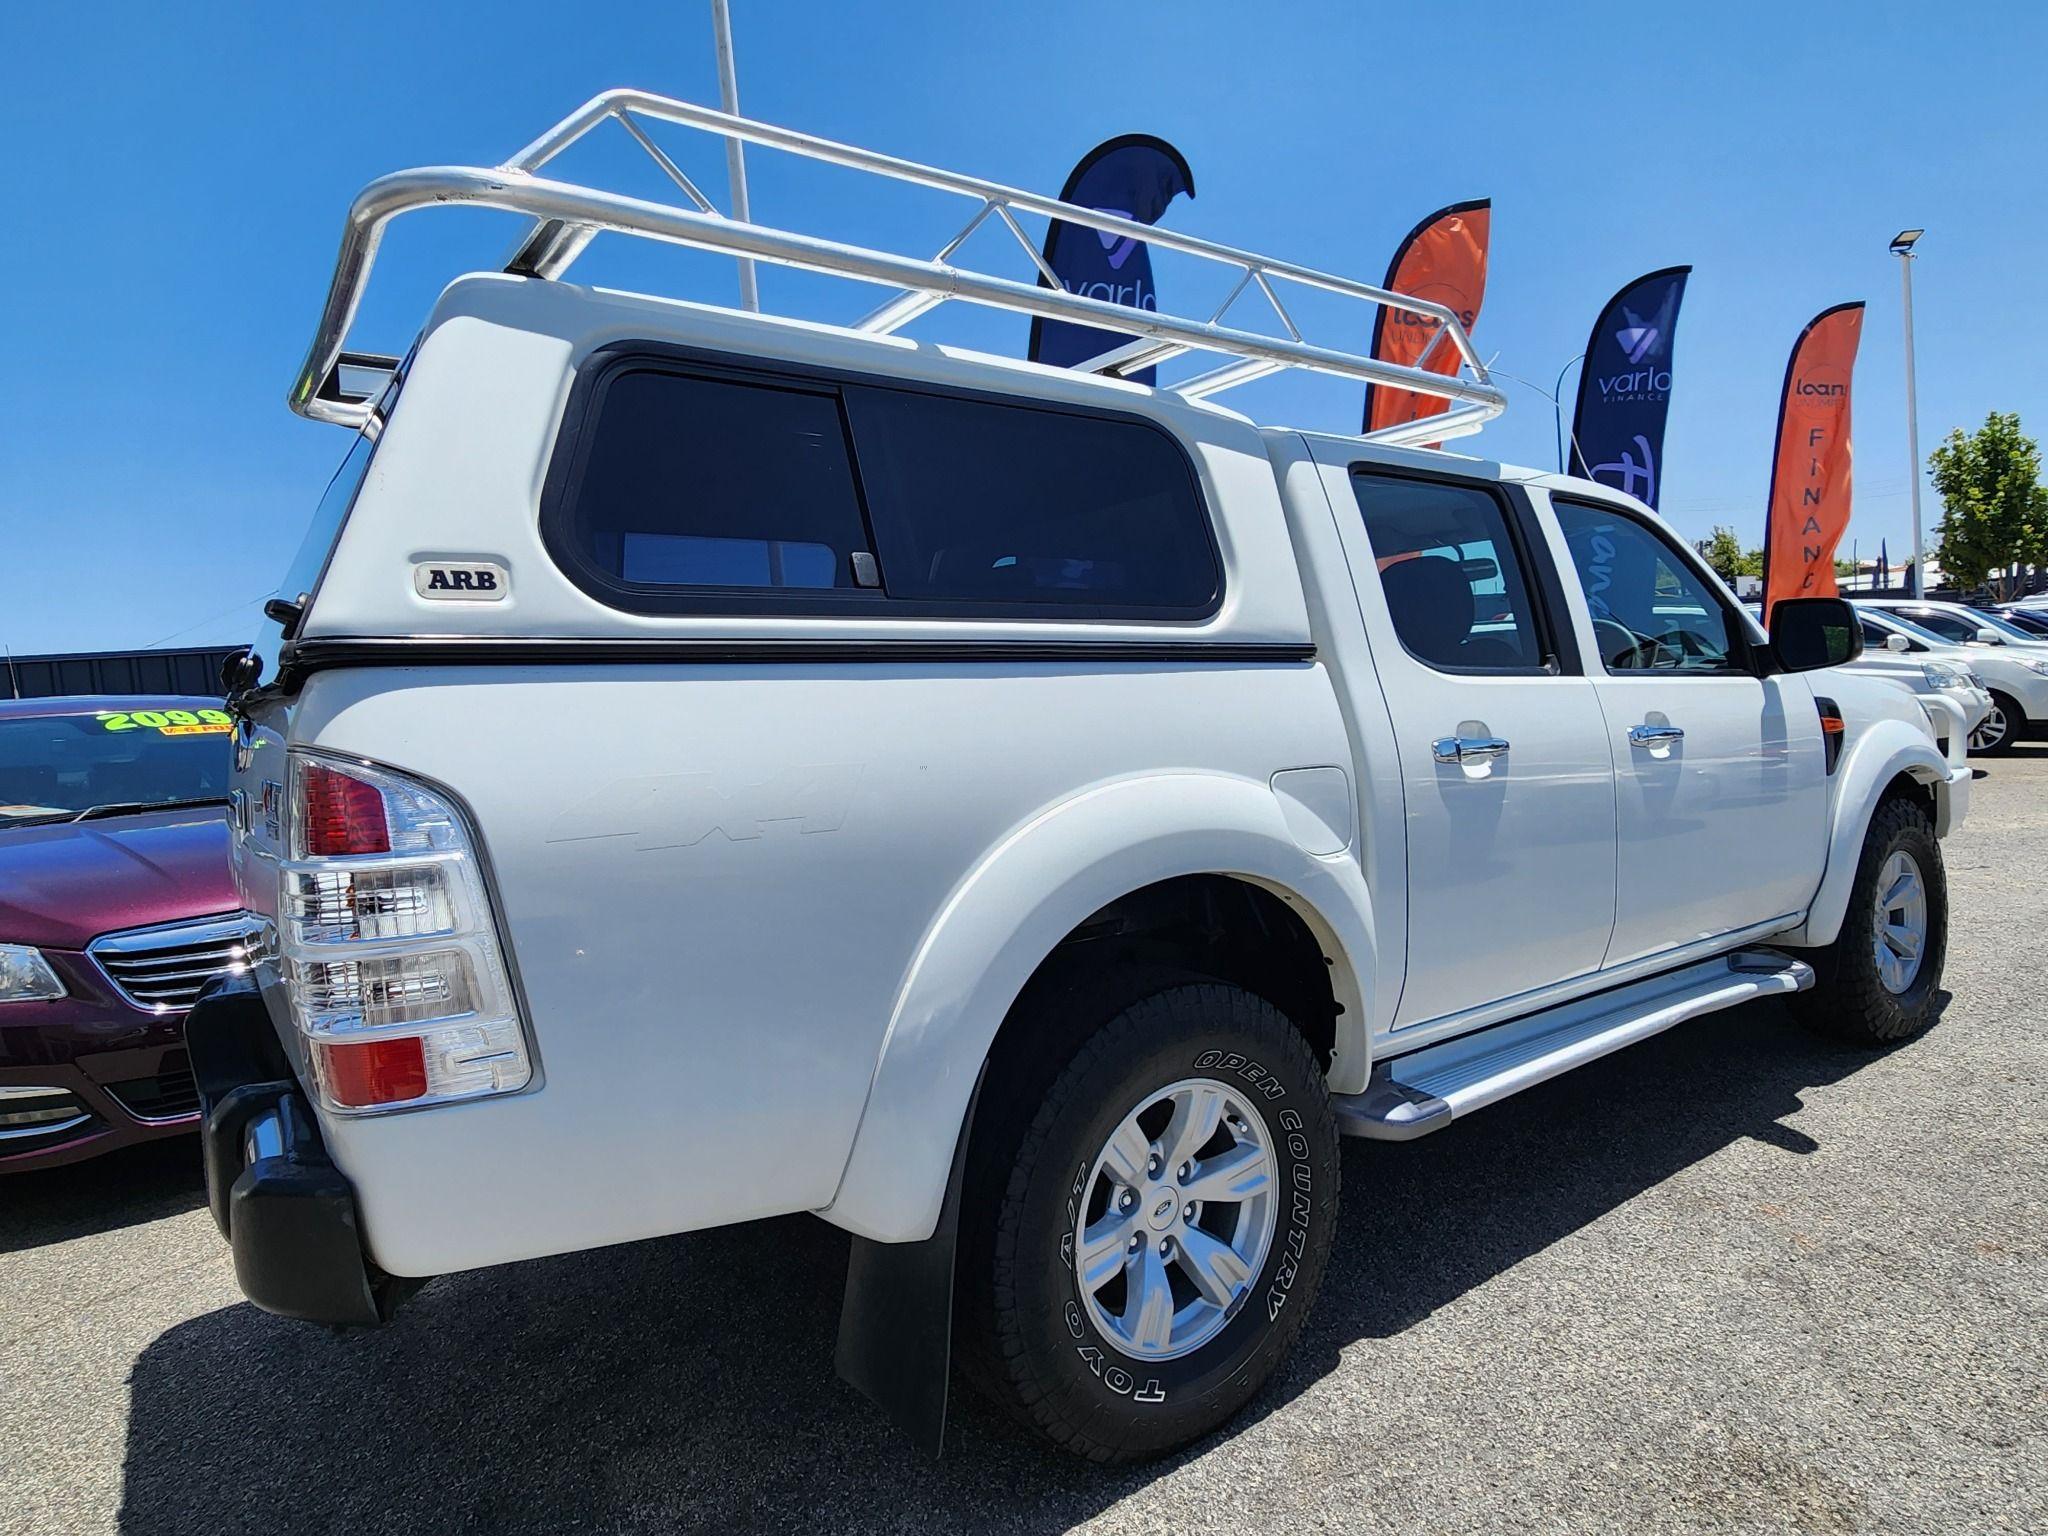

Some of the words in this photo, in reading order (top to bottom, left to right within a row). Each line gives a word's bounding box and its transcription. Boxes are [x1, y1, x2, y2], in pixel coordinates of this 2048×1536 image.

[1599, 366, 1673, 395] varlo
[1796, 378, 1849, 396] loan
[1603, 393, 1664, 403] FINANCE
[428, 569, 498, 591] ARB
[1194, 1050, 1286, 1101] OPEN
[1268, 1109, 1312, 1323] COUNTRY
[1064, 1300, 1166, 1403] TOYO
